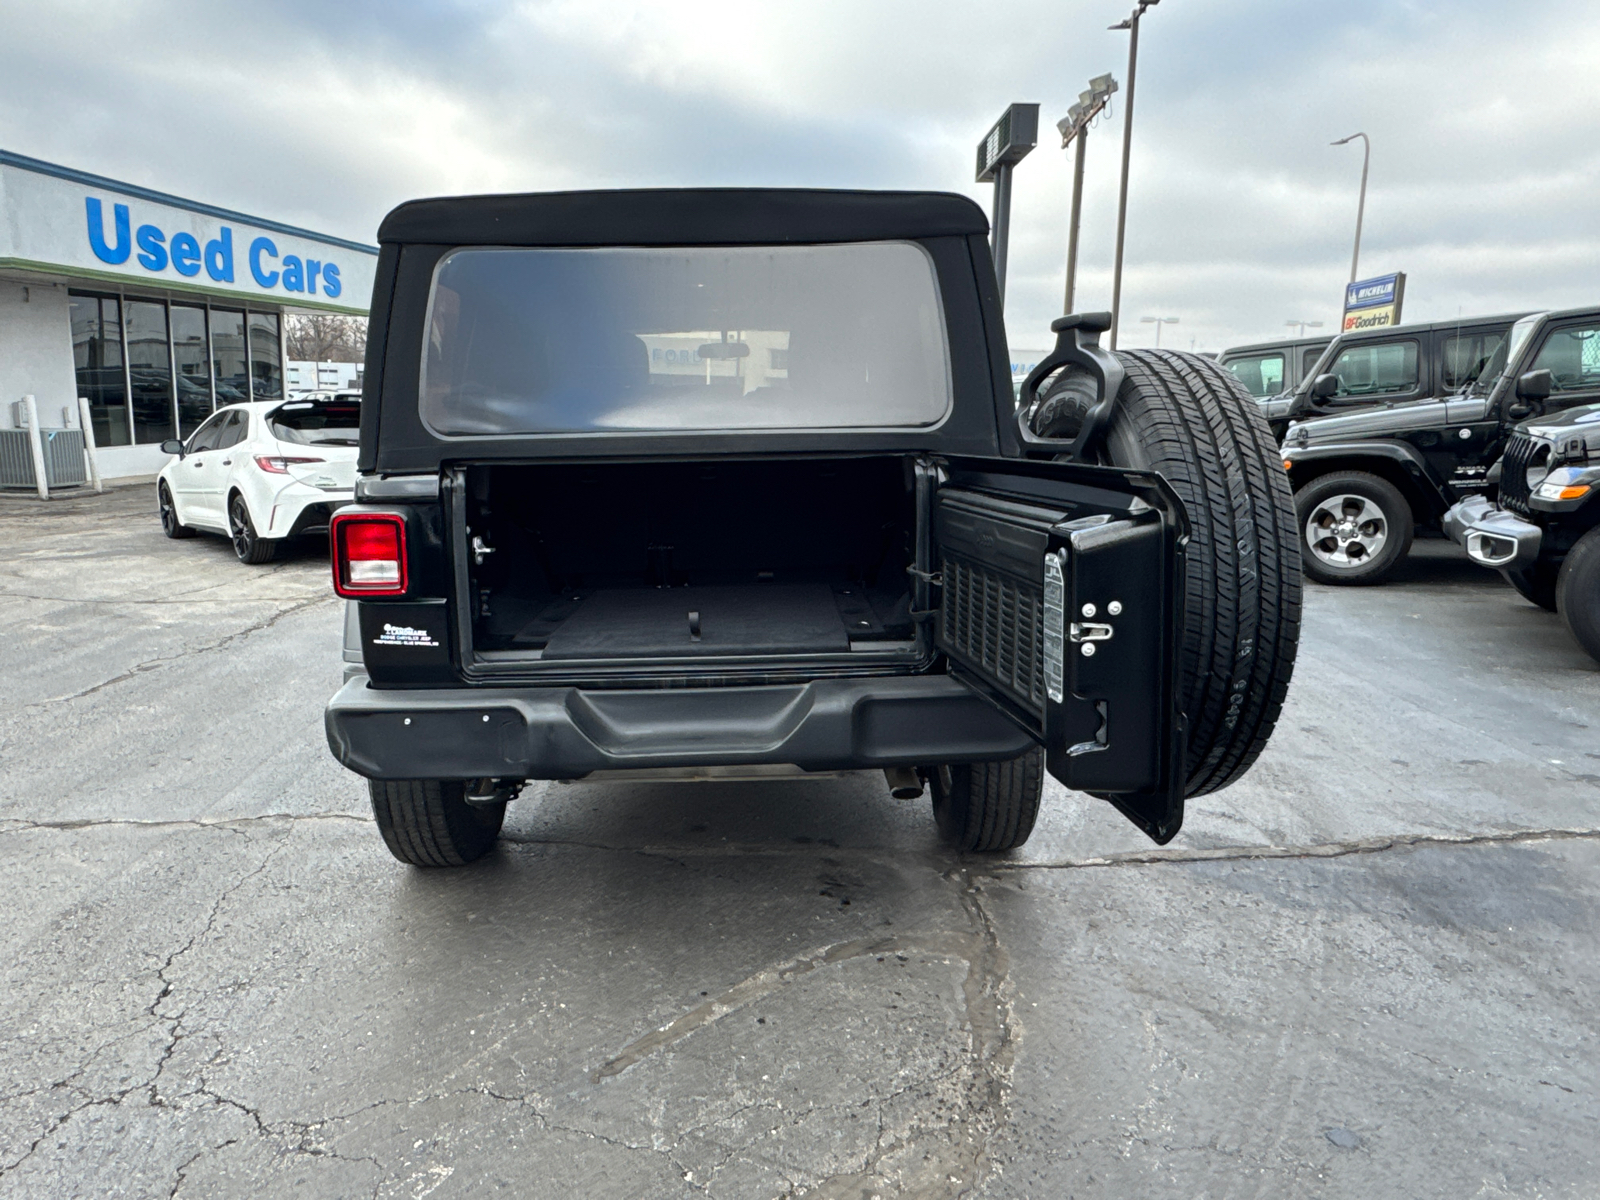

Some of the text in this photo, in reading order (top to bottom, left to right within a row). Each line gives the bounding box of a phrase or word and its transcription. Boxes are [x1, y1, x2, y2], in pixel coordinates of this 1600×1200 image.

[86, 196, 342, 298] Used Cars
[1357, 282, 1394, 298] MICHELIN
[1345, 312, 1390, 330] BFGoodrich
